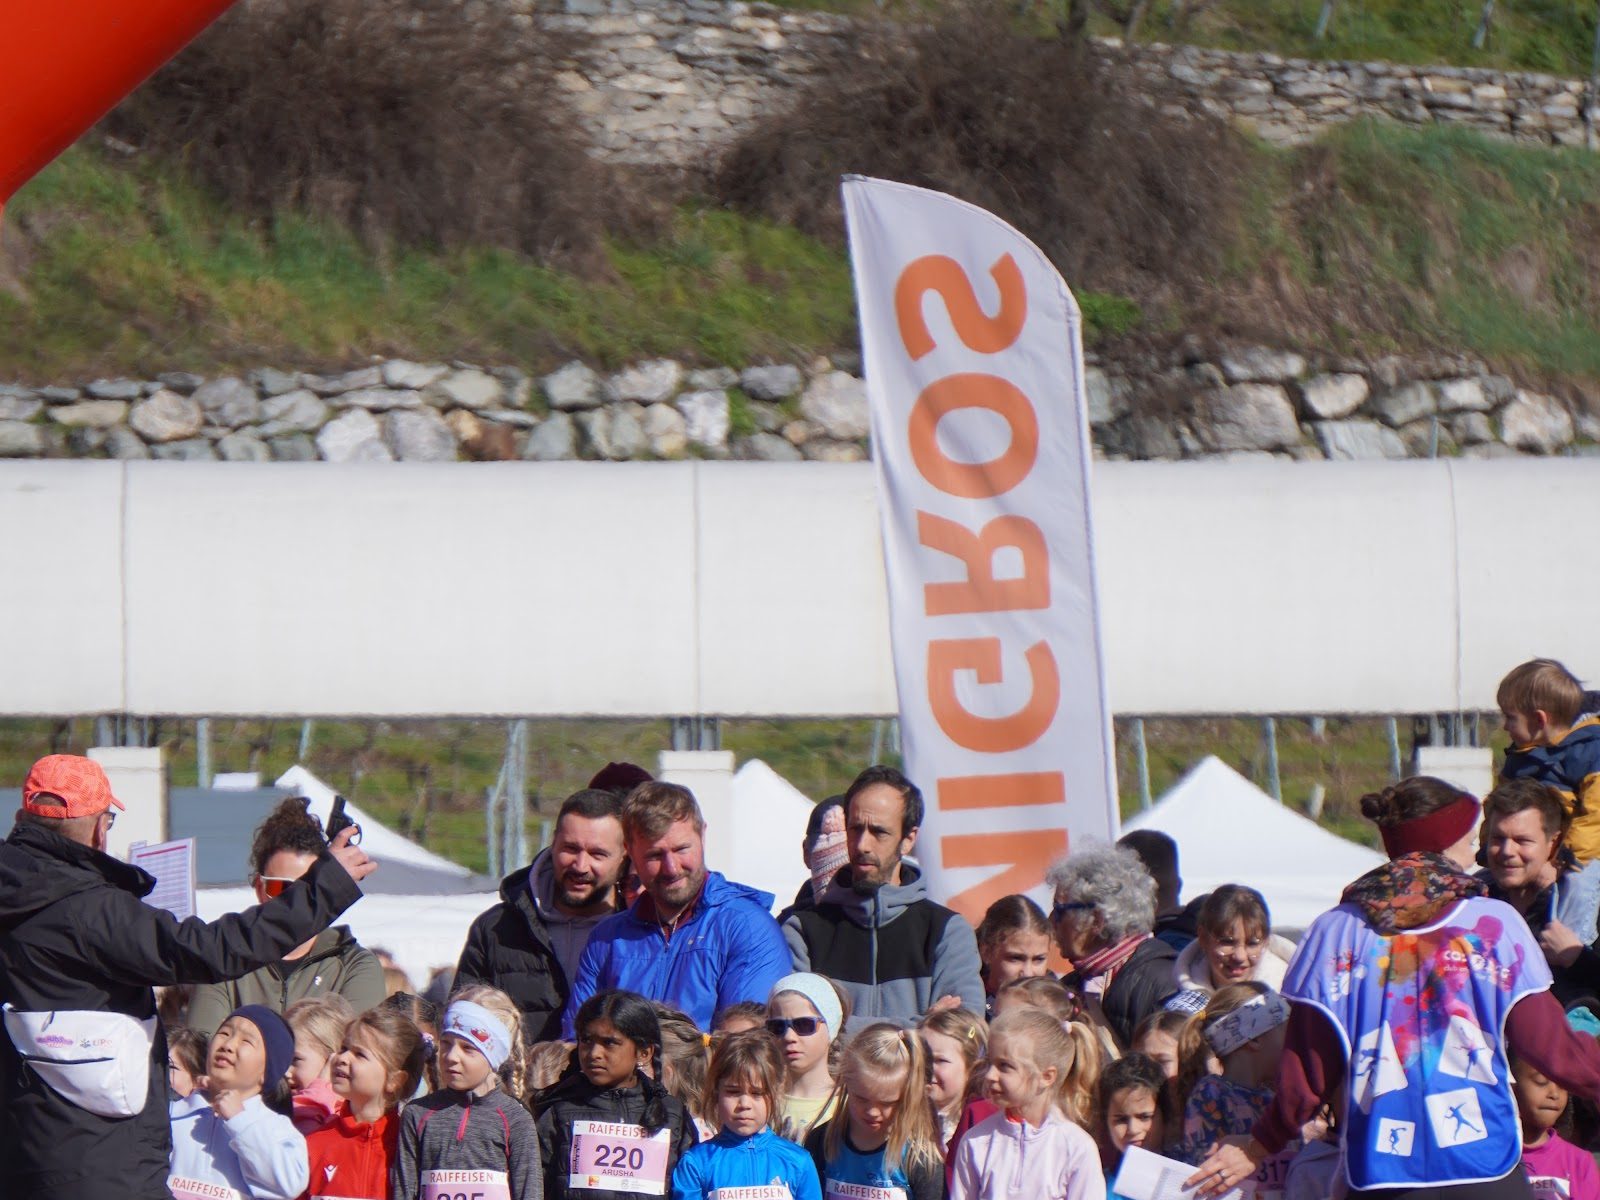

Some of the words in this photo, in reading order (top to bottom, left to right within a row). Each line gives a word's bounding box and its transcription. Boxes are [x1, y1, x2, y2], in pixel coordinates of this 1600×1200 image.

[593, 1144, 644, 1170] 220
[430, 1171, 494, 1183] RAIFFEISEN
[602, 1168, 635, 1178] ARUSHA
[172, 1177, 234, 1200] RAIFFEISEN
[719, 1187, 784, 1200] RAIFFEISEN
[834, 1183, 891, 1200] RAIFFEISEN
